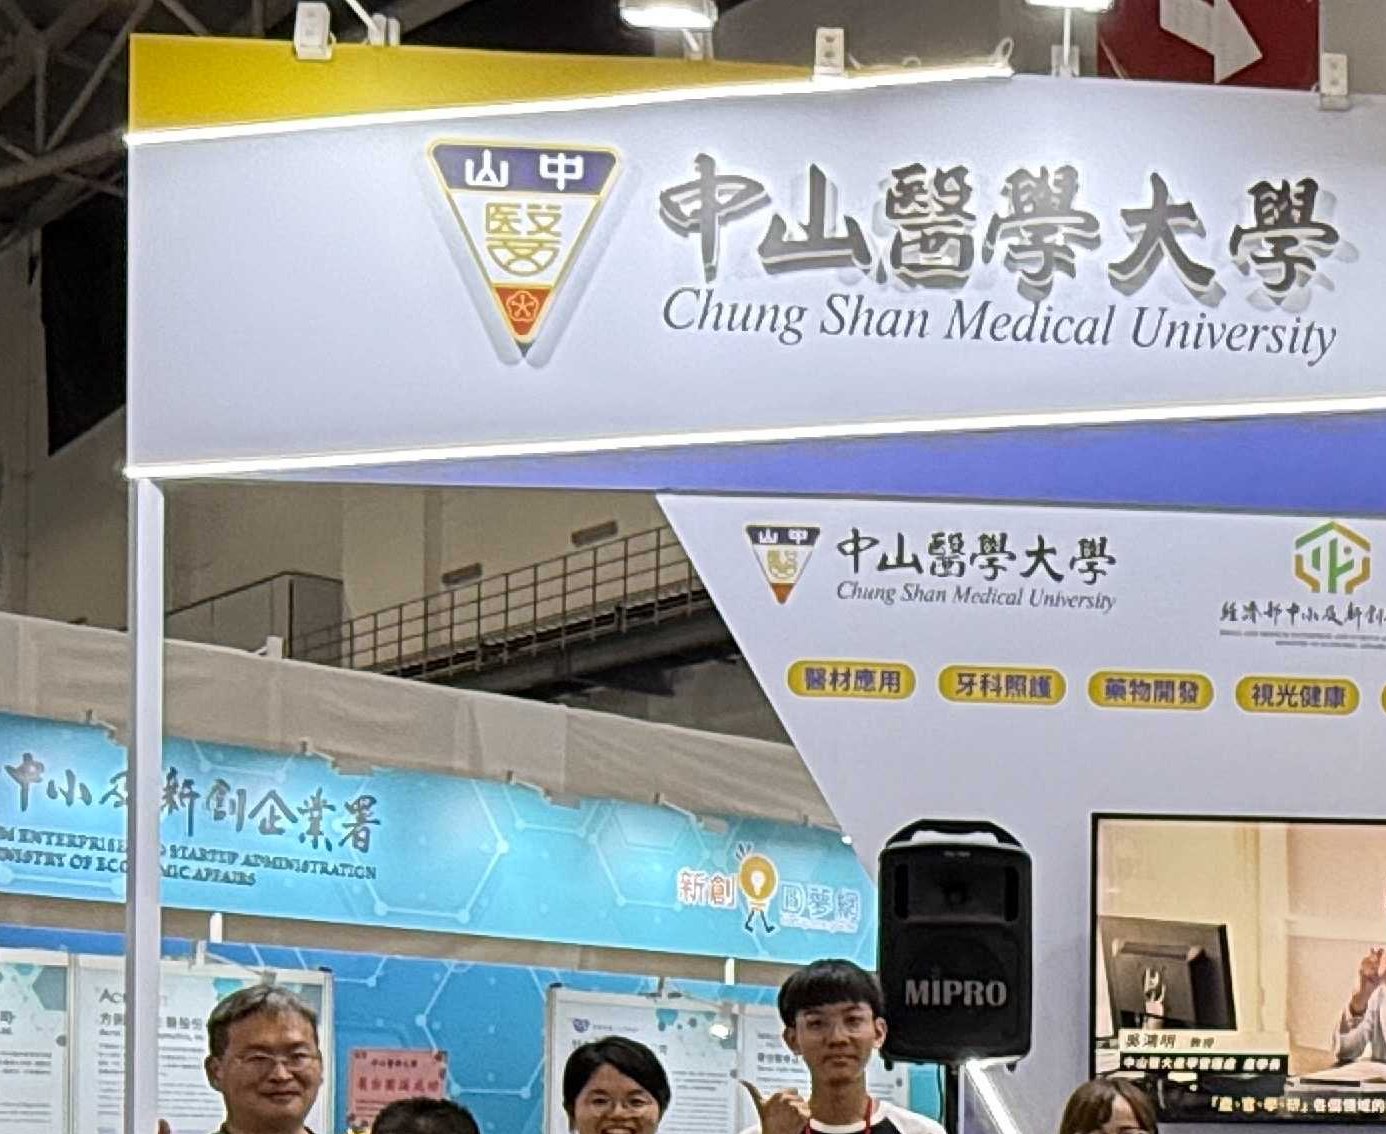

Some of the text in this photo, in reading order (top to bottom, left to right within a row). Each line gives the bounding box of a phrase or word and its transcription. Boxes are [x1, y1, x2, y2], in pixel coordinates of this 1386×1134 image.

[659, 152, 1341, 303] 中山醫學大學
[663, 287, 1338, 368] Chung Shan Medical University
[837, 527, 1117, 585] 中山醫學大學
[837, 580, 1117, 615] Chung Shan Medical University
[70, 853, 92, 870] OF
[904, 973, 1008, 1007] MIPRO
